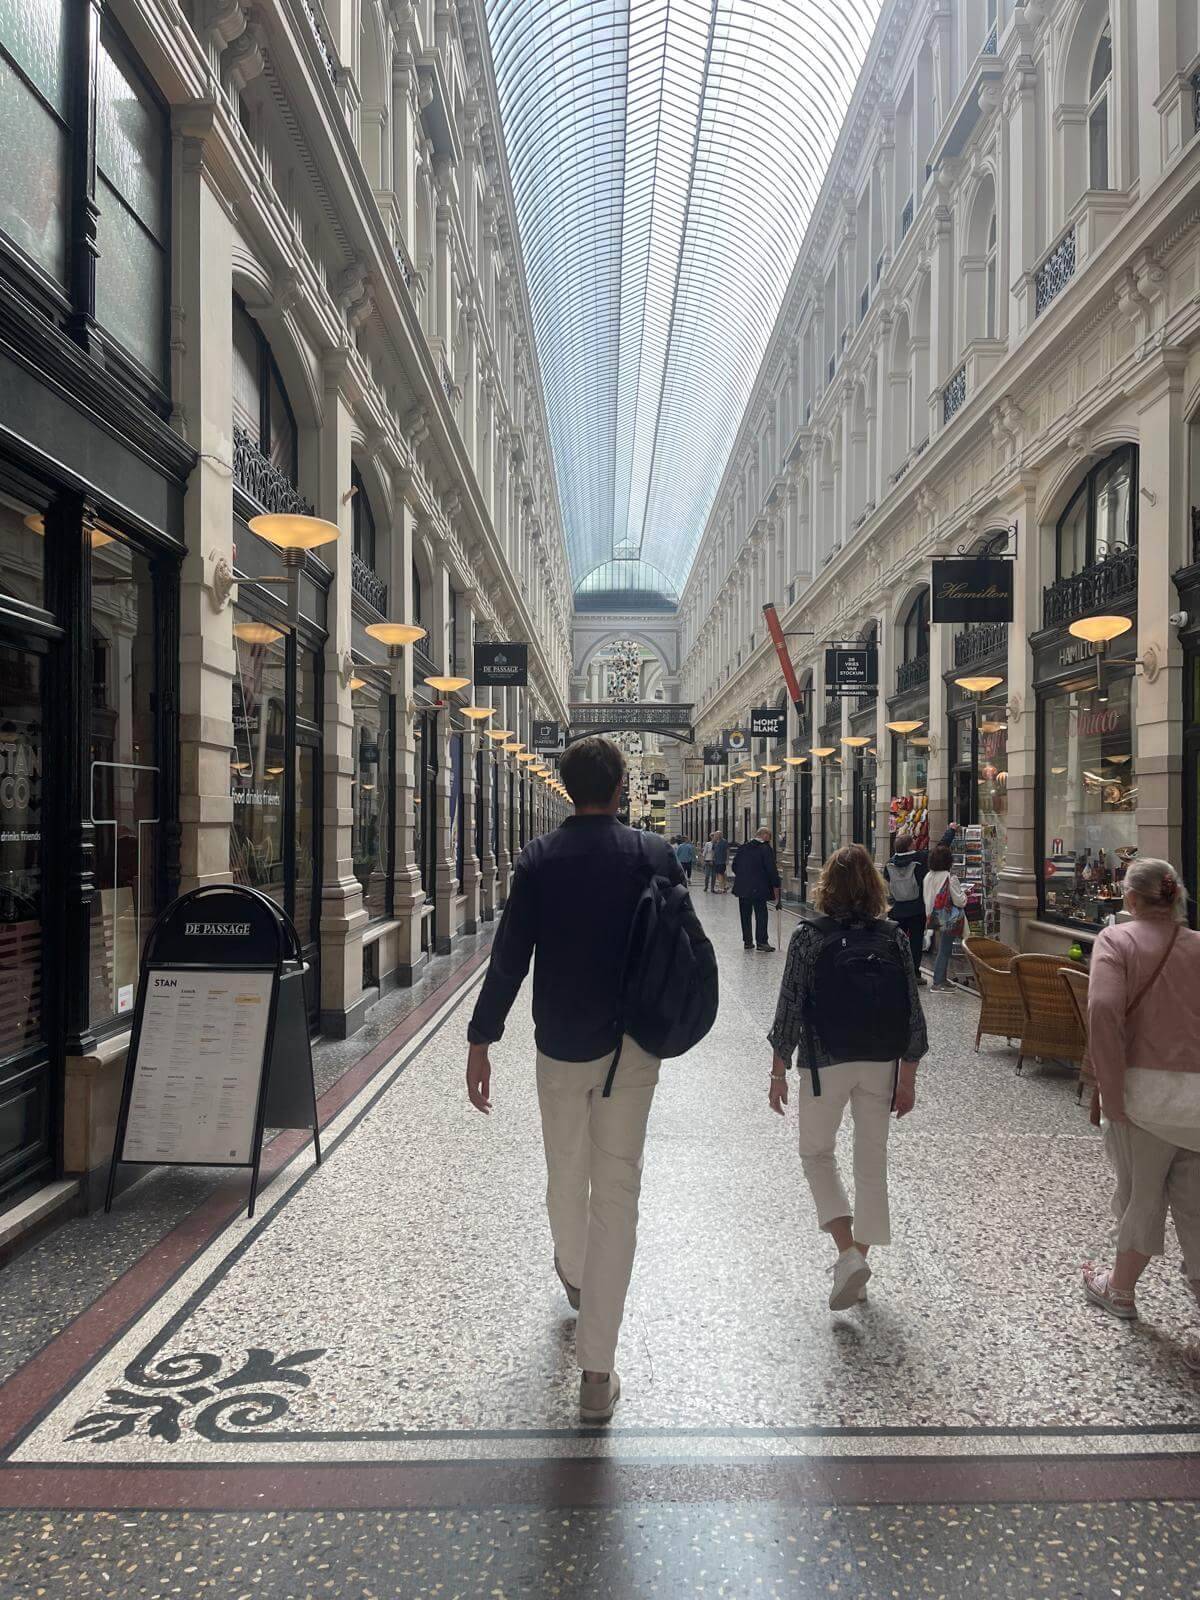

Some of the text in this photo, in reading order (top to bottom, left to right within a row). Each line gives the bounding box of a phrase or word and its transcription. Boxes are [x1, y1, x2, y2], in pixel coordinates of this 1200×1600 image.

[936, 582, 1009, 599] Hamilton
[483, 665, 519, 673] DE PASSAGE
[753, 718, 778, 726] MONT
[753, 725, 779, 733] BLANC
[1, 777, 30, 808] CO
[231, 787, 280, 806] food drinks friends
[0, 831, 41, 842] drinks friends
[184, 923, 251, 936] DE PASSAGE
[154, 979, 178, 988] STAN
